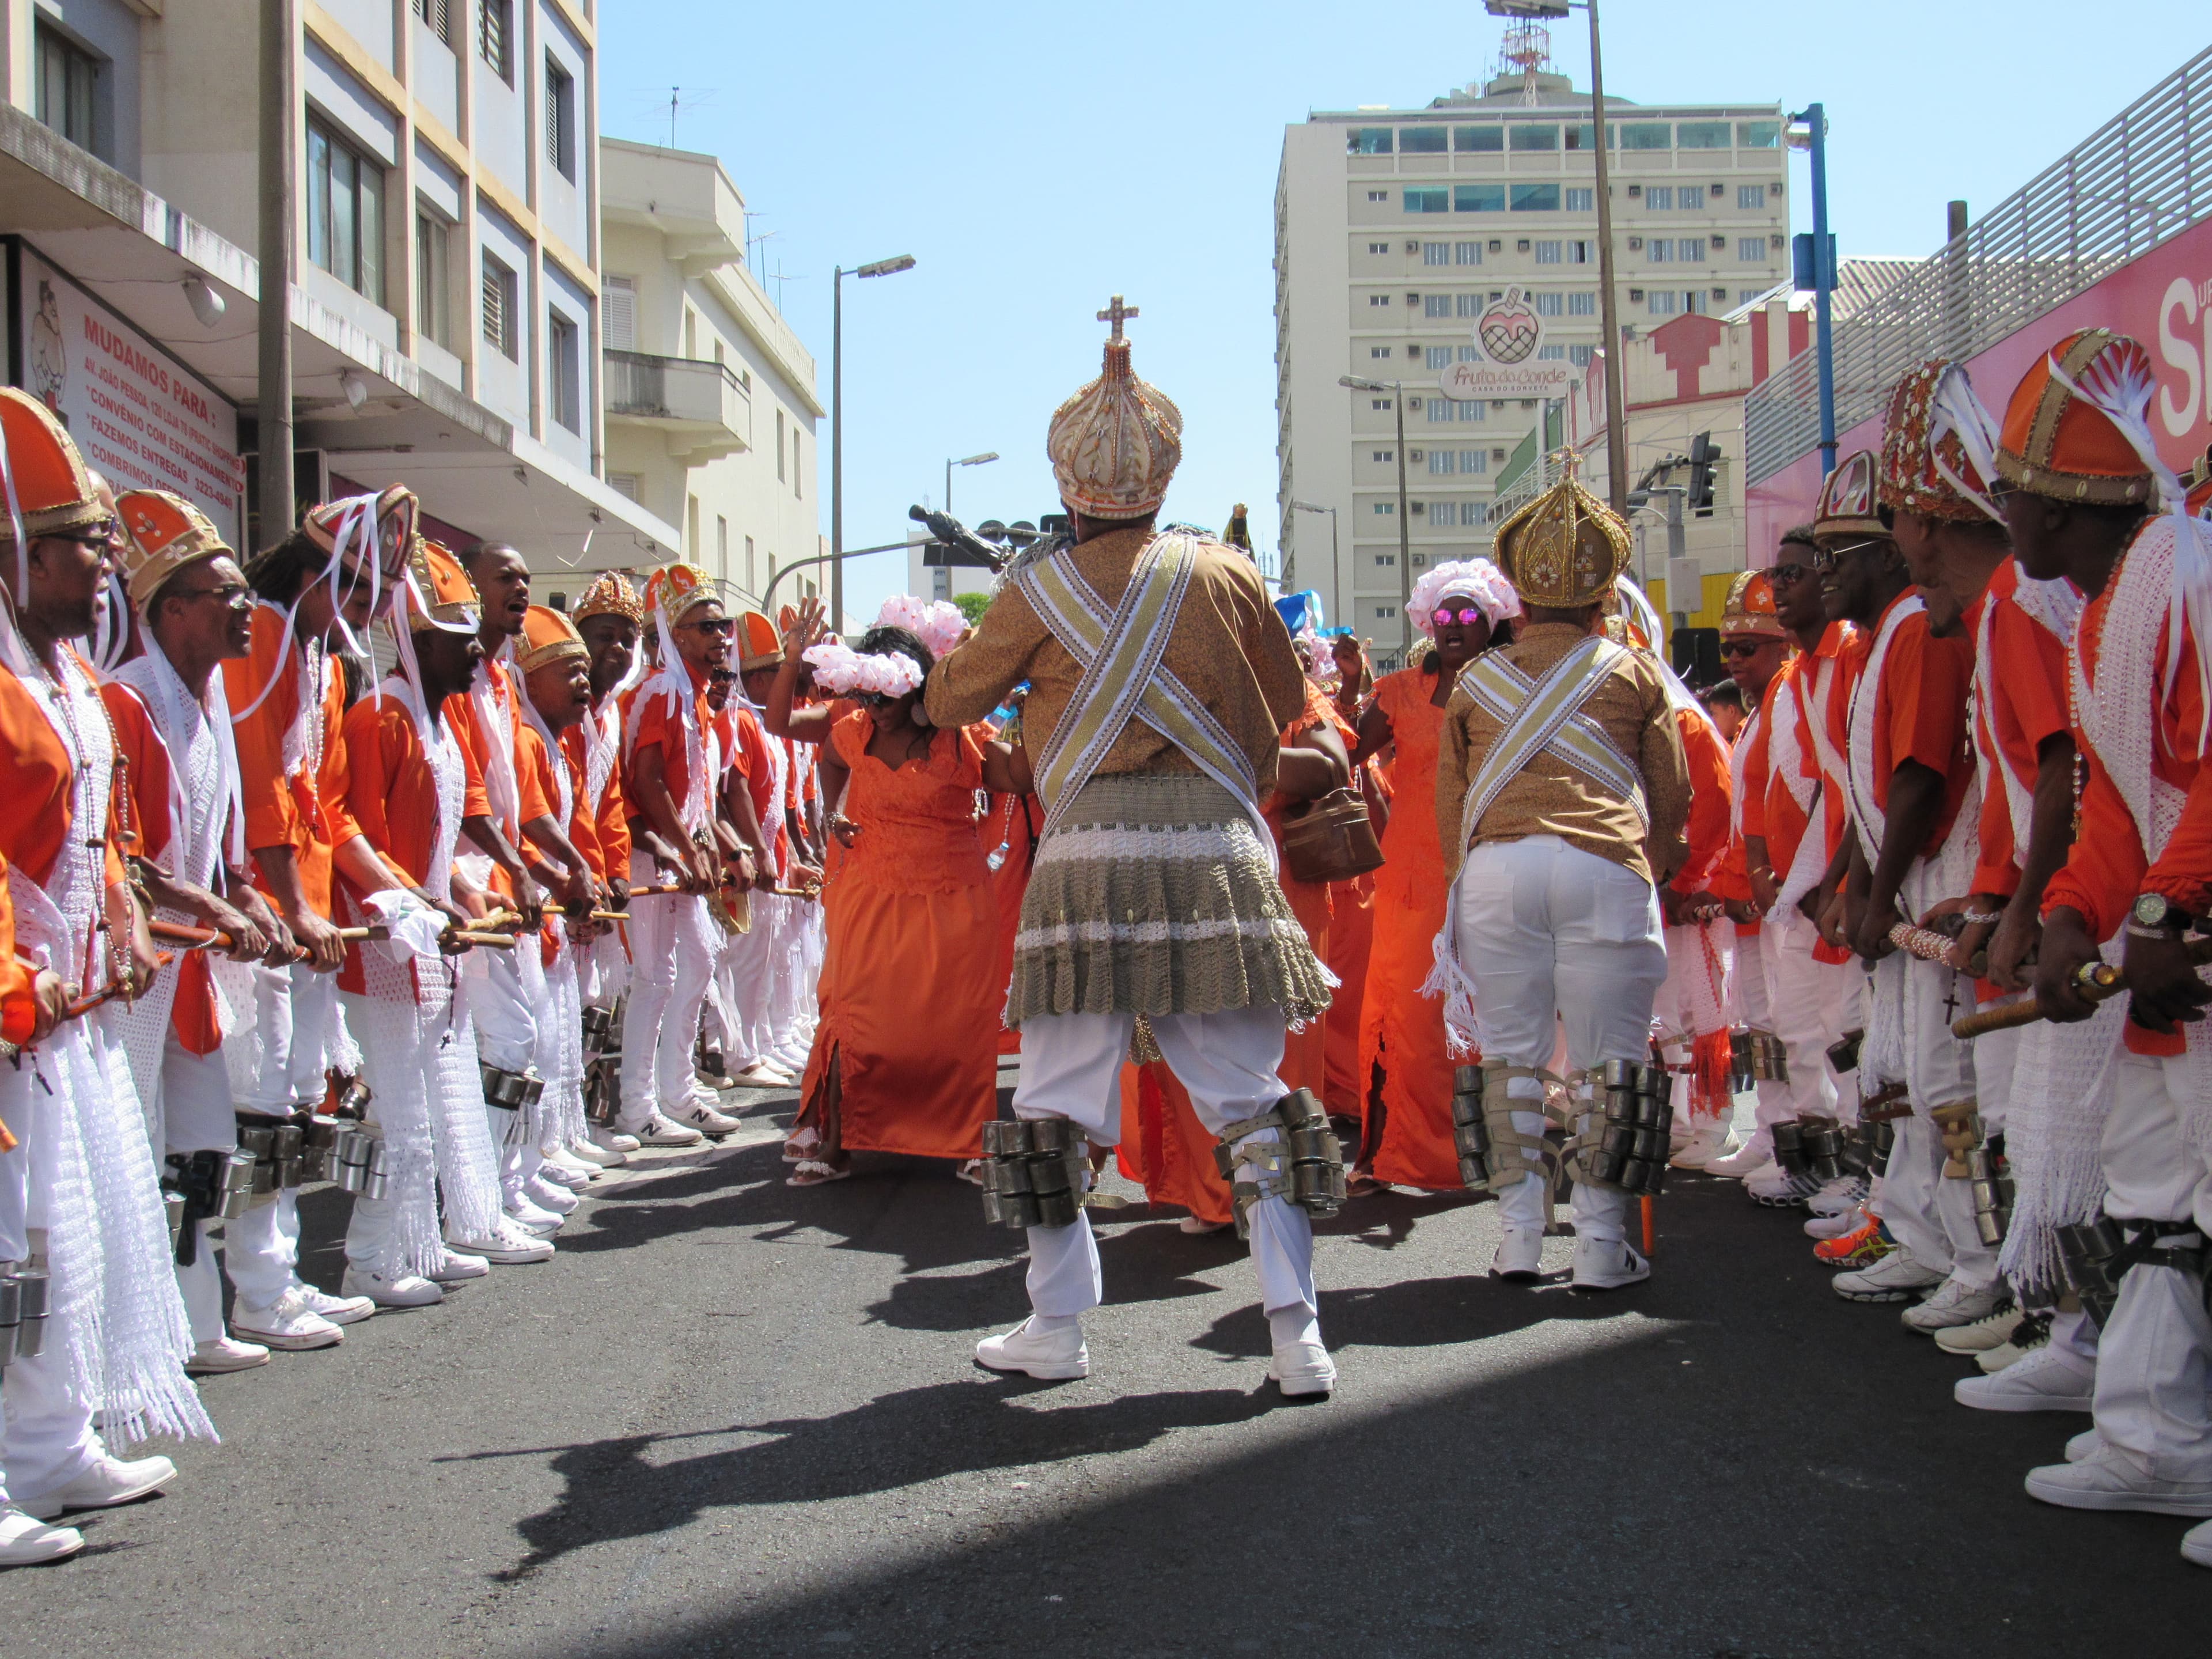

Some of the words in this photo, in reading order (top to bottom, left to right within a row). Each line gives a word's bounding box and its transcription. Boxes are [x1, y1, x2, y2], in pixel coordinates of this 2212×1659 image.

[84, 313, 168, 394] MUDAMOS
[173, 378, 210, 425] PARA
[85, 356, 97, 377] AV.
[98, 366, 119, 390] JOÃO
[164, 408, 180, 429] LOJA
[141, 444, 188, 484] ENTREGAS
[195, 478, 233, 511] 3223-4949
[147, 423, 167, 447] COM
[169, 437, 245, 493] ESTACIONAMENTO
